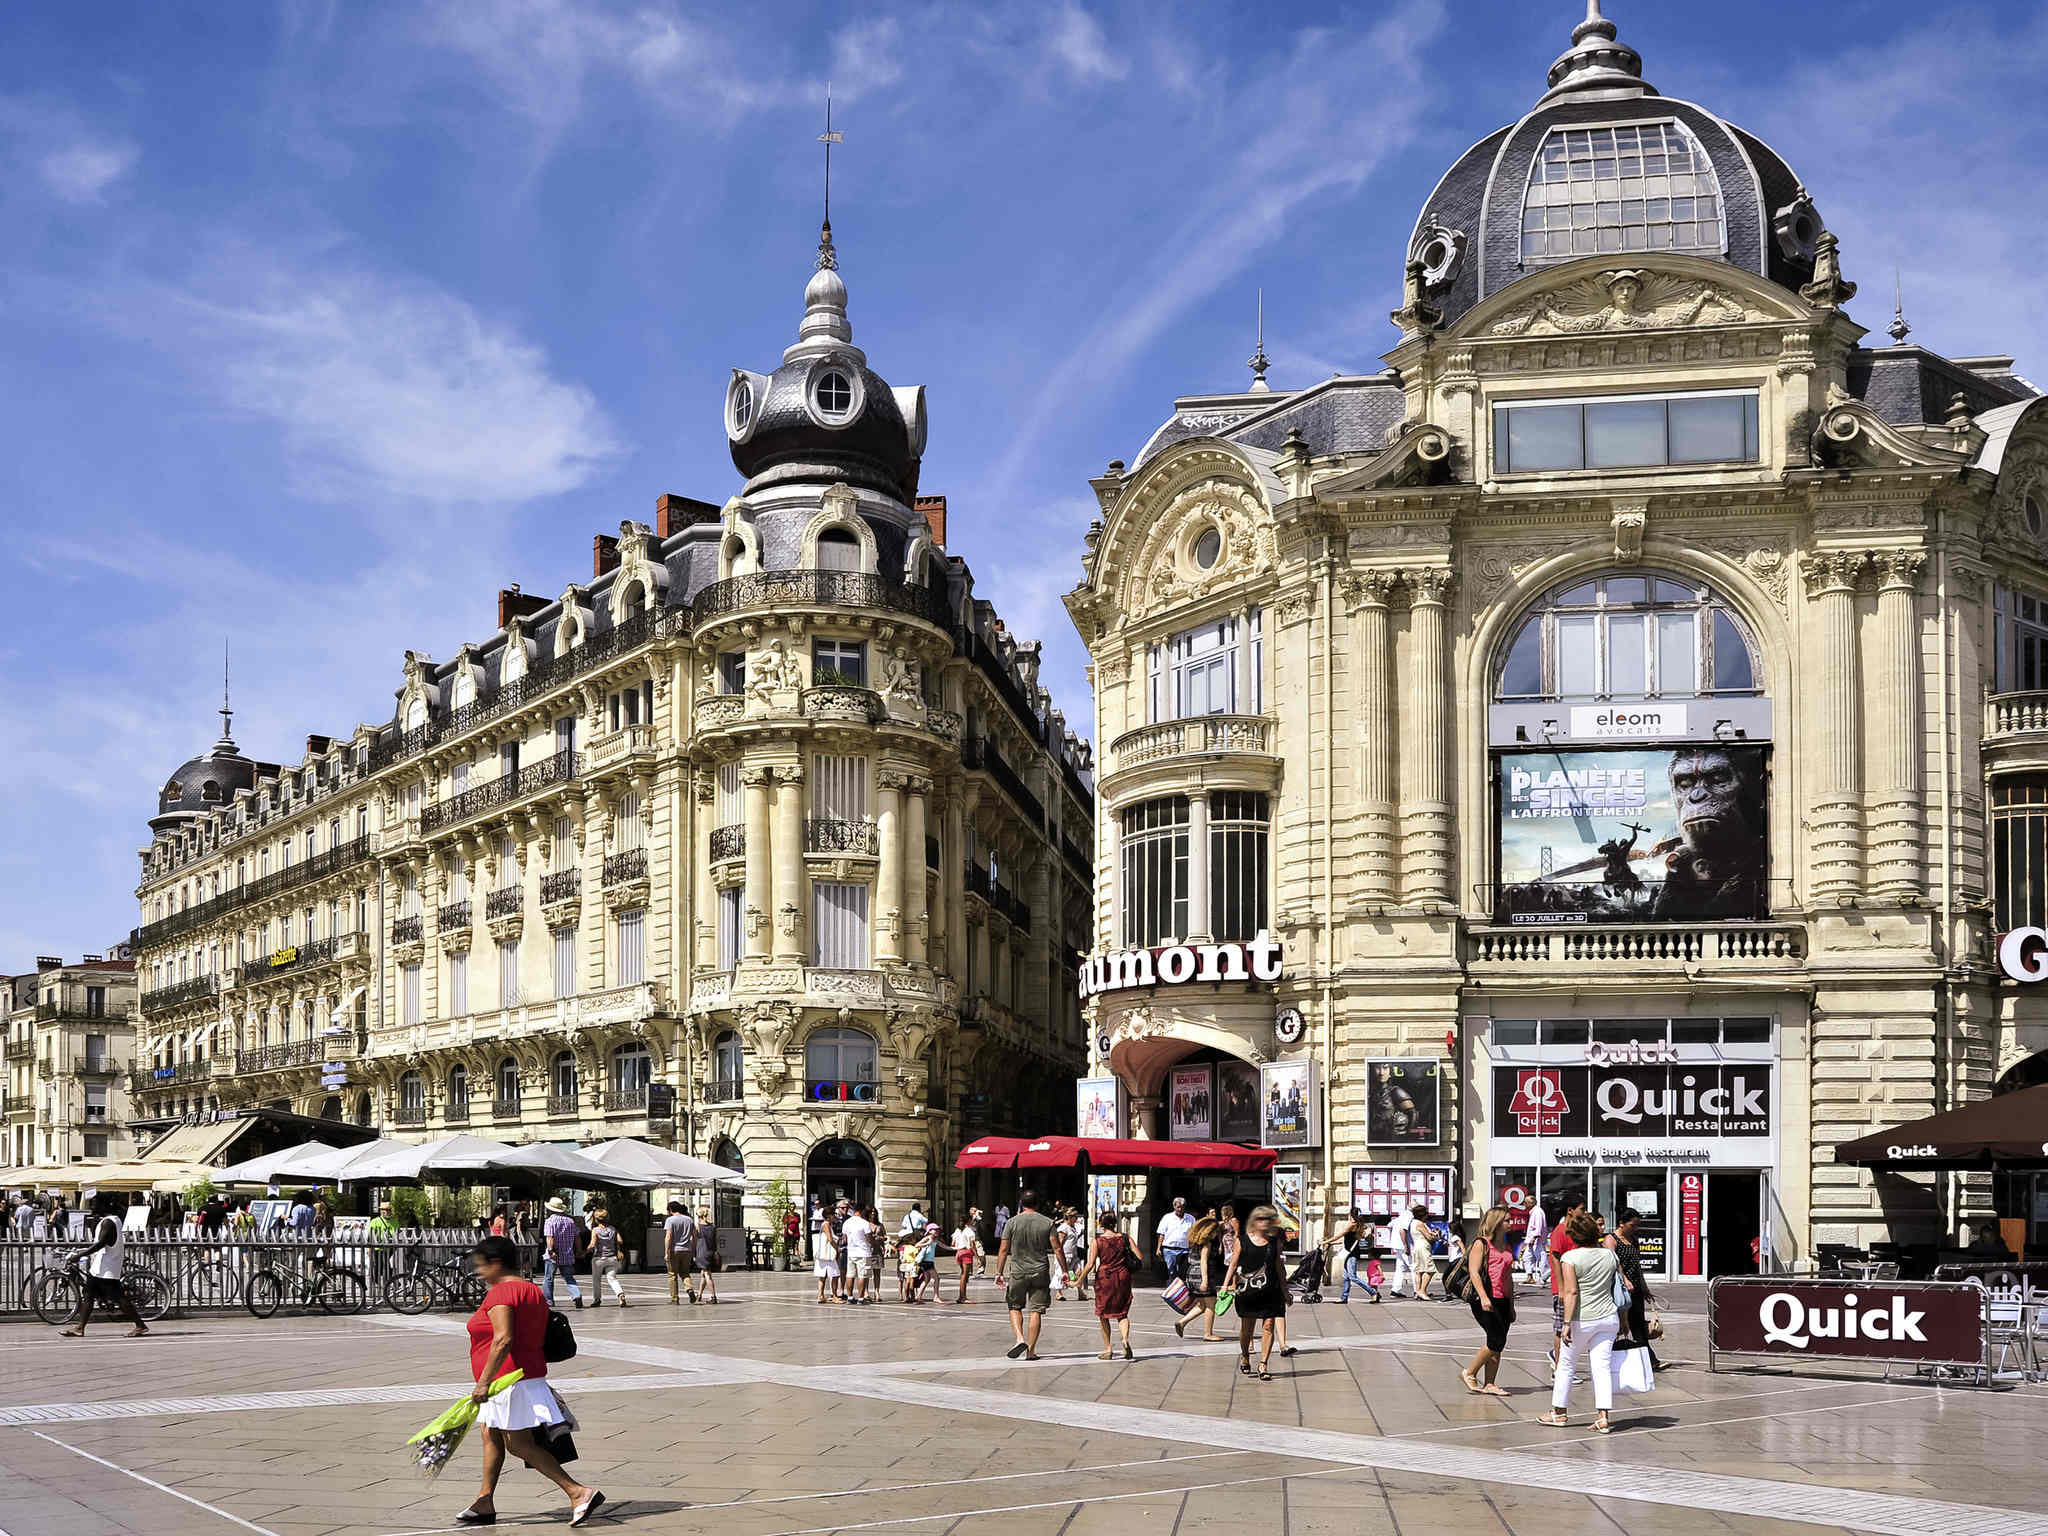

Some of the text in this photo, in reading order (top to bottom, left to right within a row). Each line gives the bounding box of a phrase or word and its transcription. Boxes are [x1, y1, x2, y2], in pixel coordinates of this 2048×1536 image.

[1596, 709, 1661, 725] eleom
[1596, 727, 1661, 735] avocats
[1511, 764, 1646, 795] PLANÈTE
[1529, 787, 1647, 809] SINGES
[1511, 808, 1646, 819] L'AFFRONTEMENT
[1280, 1016, 1295, 1035] G
[1586, 1039, 1678, 1068] Quick
[814, 1081, 873, 1102] CIC
[1523, 1076, 1558, 1107] Q
[1597, 1075, 1766, 1124] Quick
[1520, 1116, 1558, 1127] Quick
[1674, 1119, 1767, 1130] Restaurant
[1554, 1147, 1710, 1159] Quality Burger Restaurant
[1886, 1145, 1938, 1159] Quick
[1685, 1176, 1699, 1190] Q
[1504, 1187, 1526, 1211] Q
[1759, 1292, 1928, 1349] Quick
